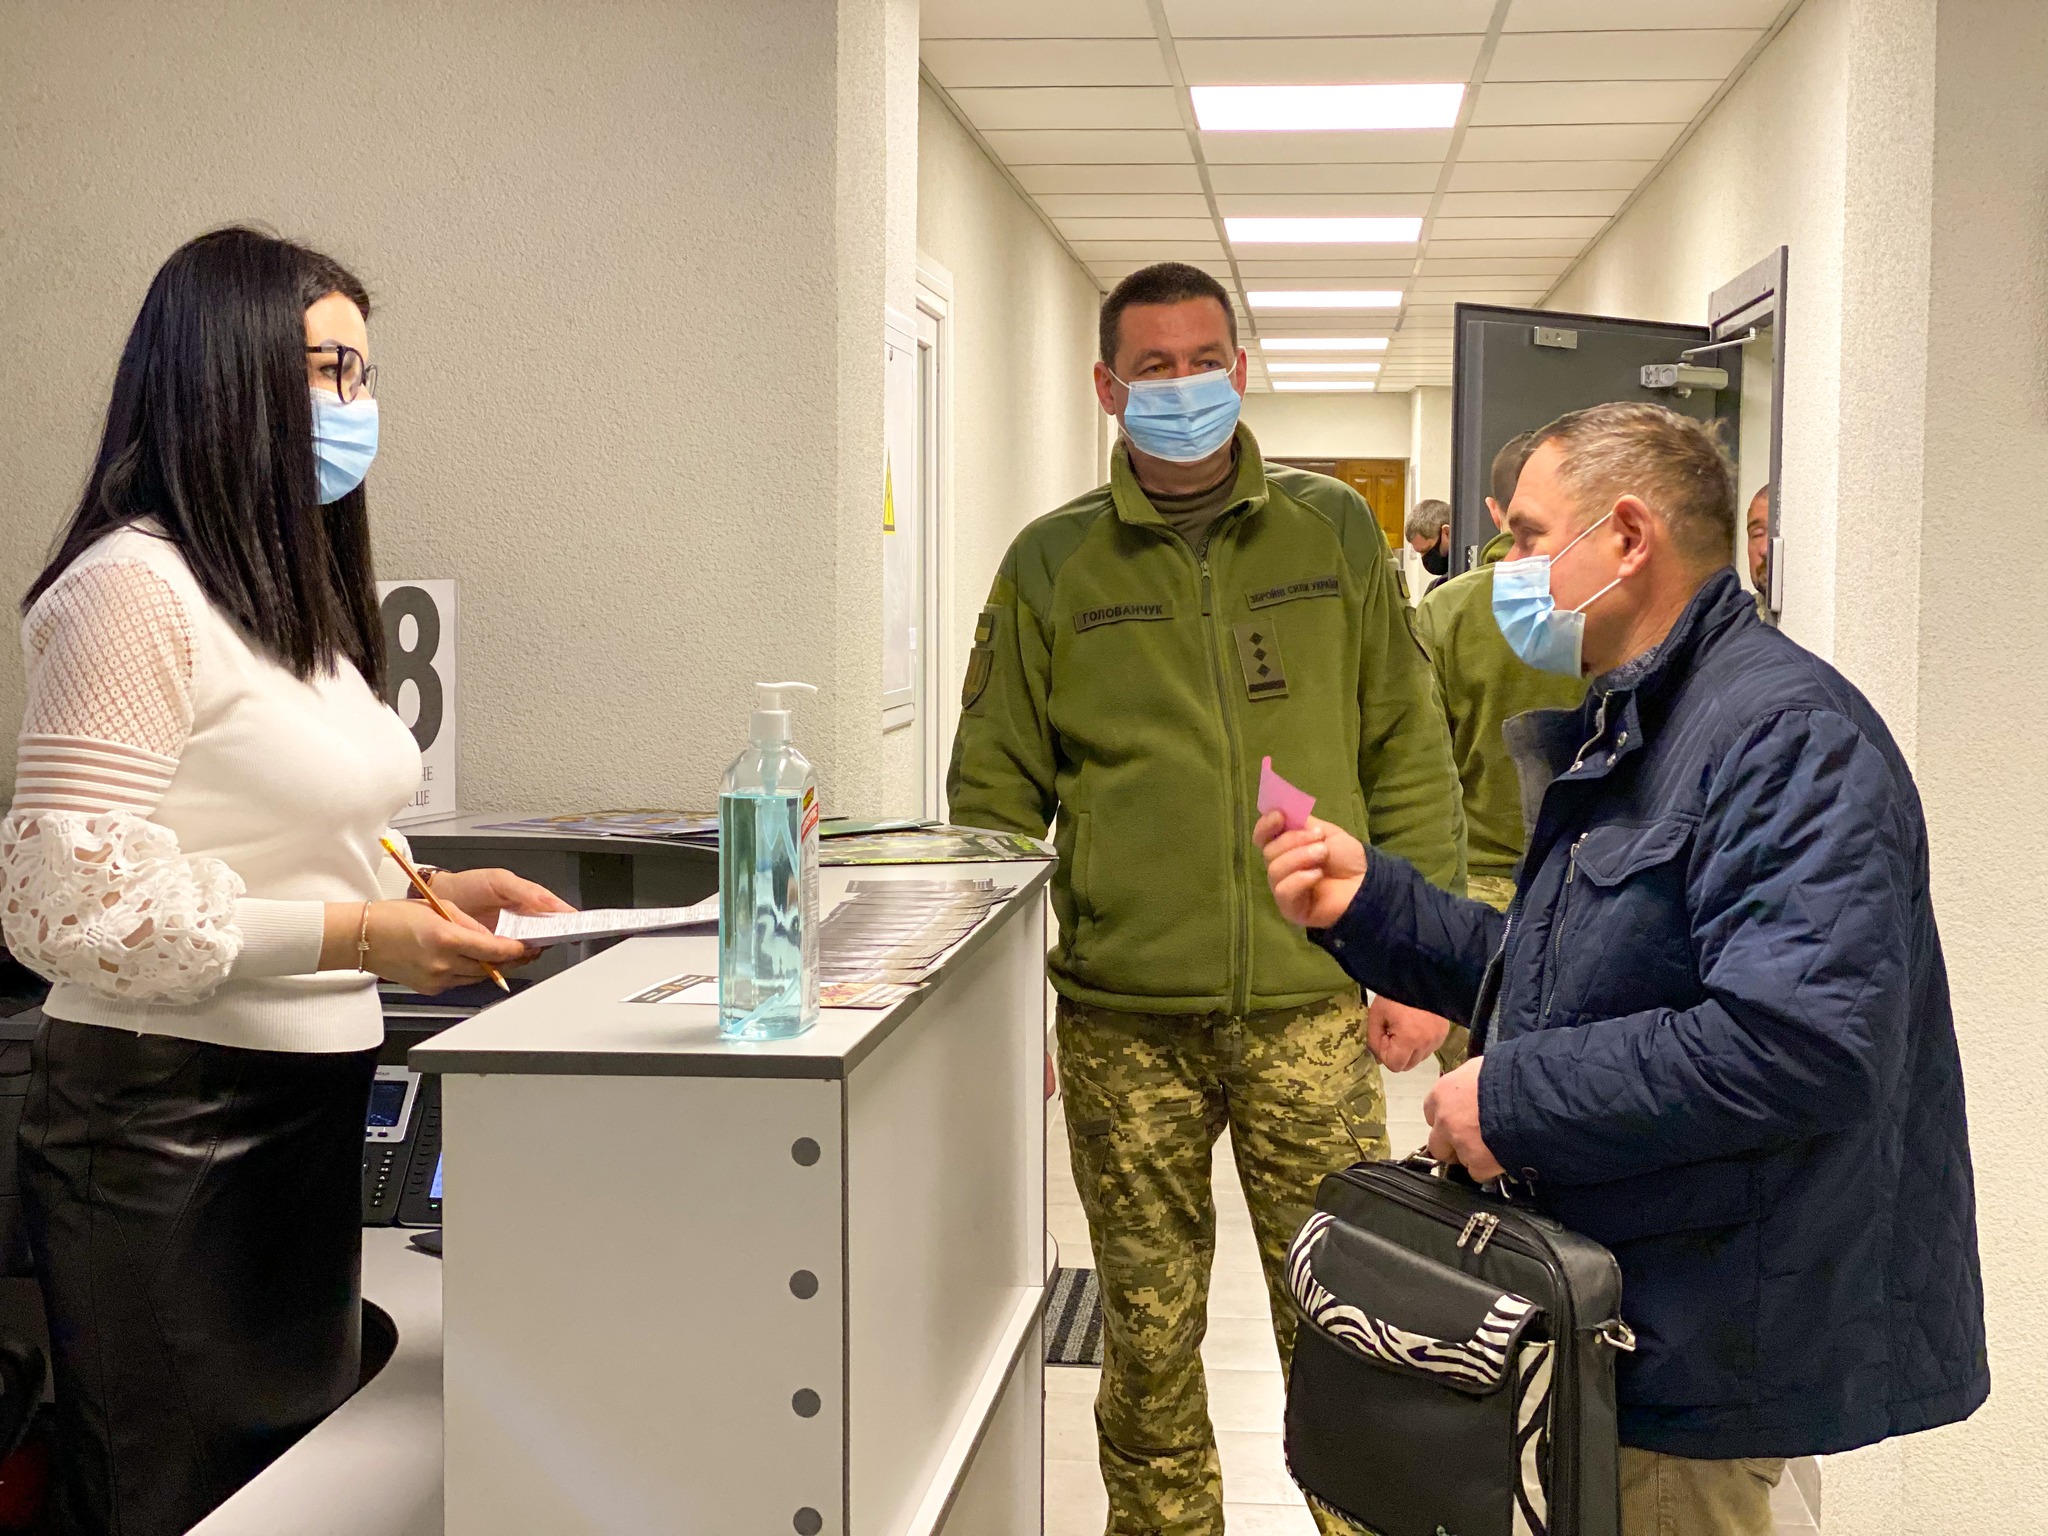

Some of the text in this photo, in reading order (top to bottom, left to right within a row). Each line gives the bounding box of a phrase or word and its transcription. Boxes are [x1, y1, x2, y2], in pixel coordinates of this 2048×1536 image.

[1287, 583, 1310, 595] СИЛИ
[1083, 605, 1163, 624] ГОЛОВАНЧУК
[381, 586, 443, 753] 8
